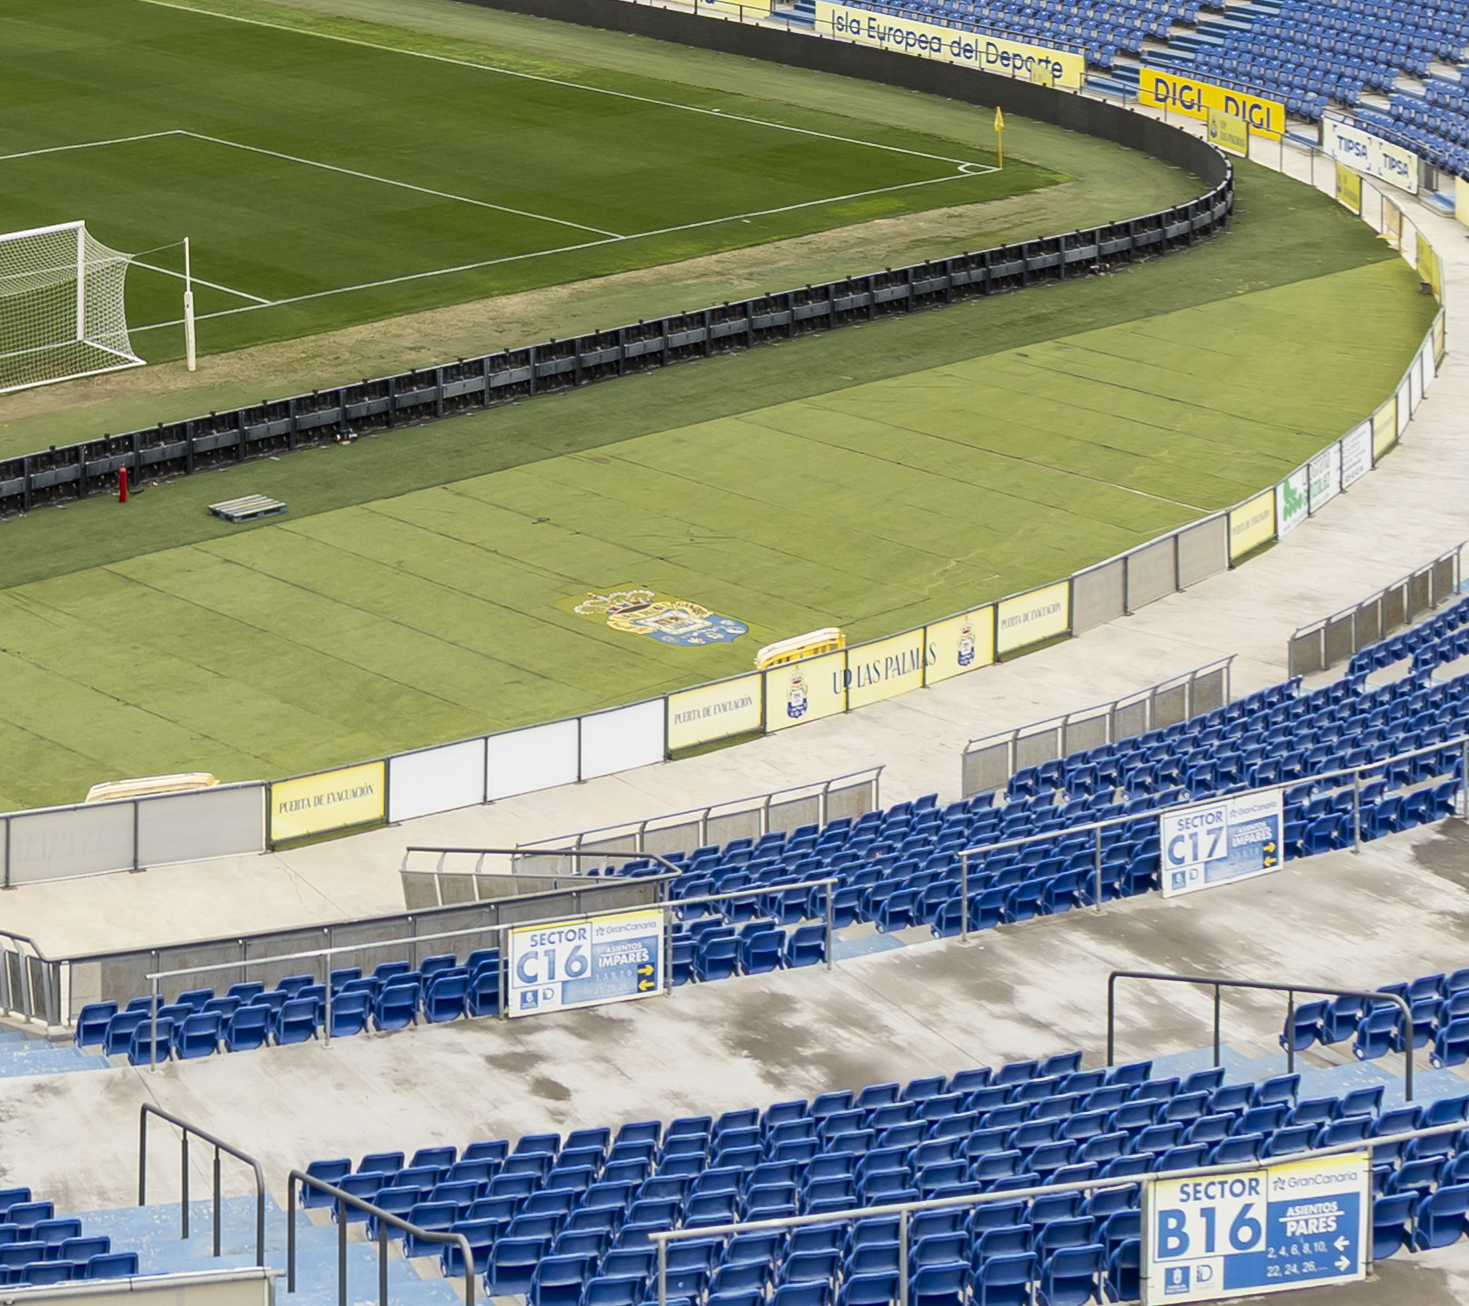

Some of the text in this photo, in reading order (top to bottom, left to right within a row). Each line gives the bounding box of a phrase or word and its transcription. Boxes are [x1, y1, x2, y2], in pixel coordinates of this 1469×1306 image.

[832, 9, 1063, 81] Isla Europea del Deporte
[1155, 78, 1202, 113] DIGI
[1224, 95, 1271, 130] DIGI
[1337, 135, 1368, 159] TIPSA
[1383, 152, 1409, 178] TIPSA
[857, 659, 884, 689] LAS
[884, 643, 937, 682] PALMAS
[279, 798, 311, 814] PUERTA
[314, 794, 324, 807] DE
[1177, 811, 1223, 832] SECTOR
[1167, 826, 1224, 866] C17
[530, 928, 587, 948] SECTOR
[516, 944, 589, 984] C16
[598, 950, 650, 968] IMPARES
[1179, 1177, 1261, 1202] SECTOR
[1288, 1171, 1357, 1188] GranCanaria
[1286, 1201, 1338, 1218] ASIENTOS
[1158, 1202, 1262, 1258] B16
[1286, 1216, 1337, 1238] PARES
